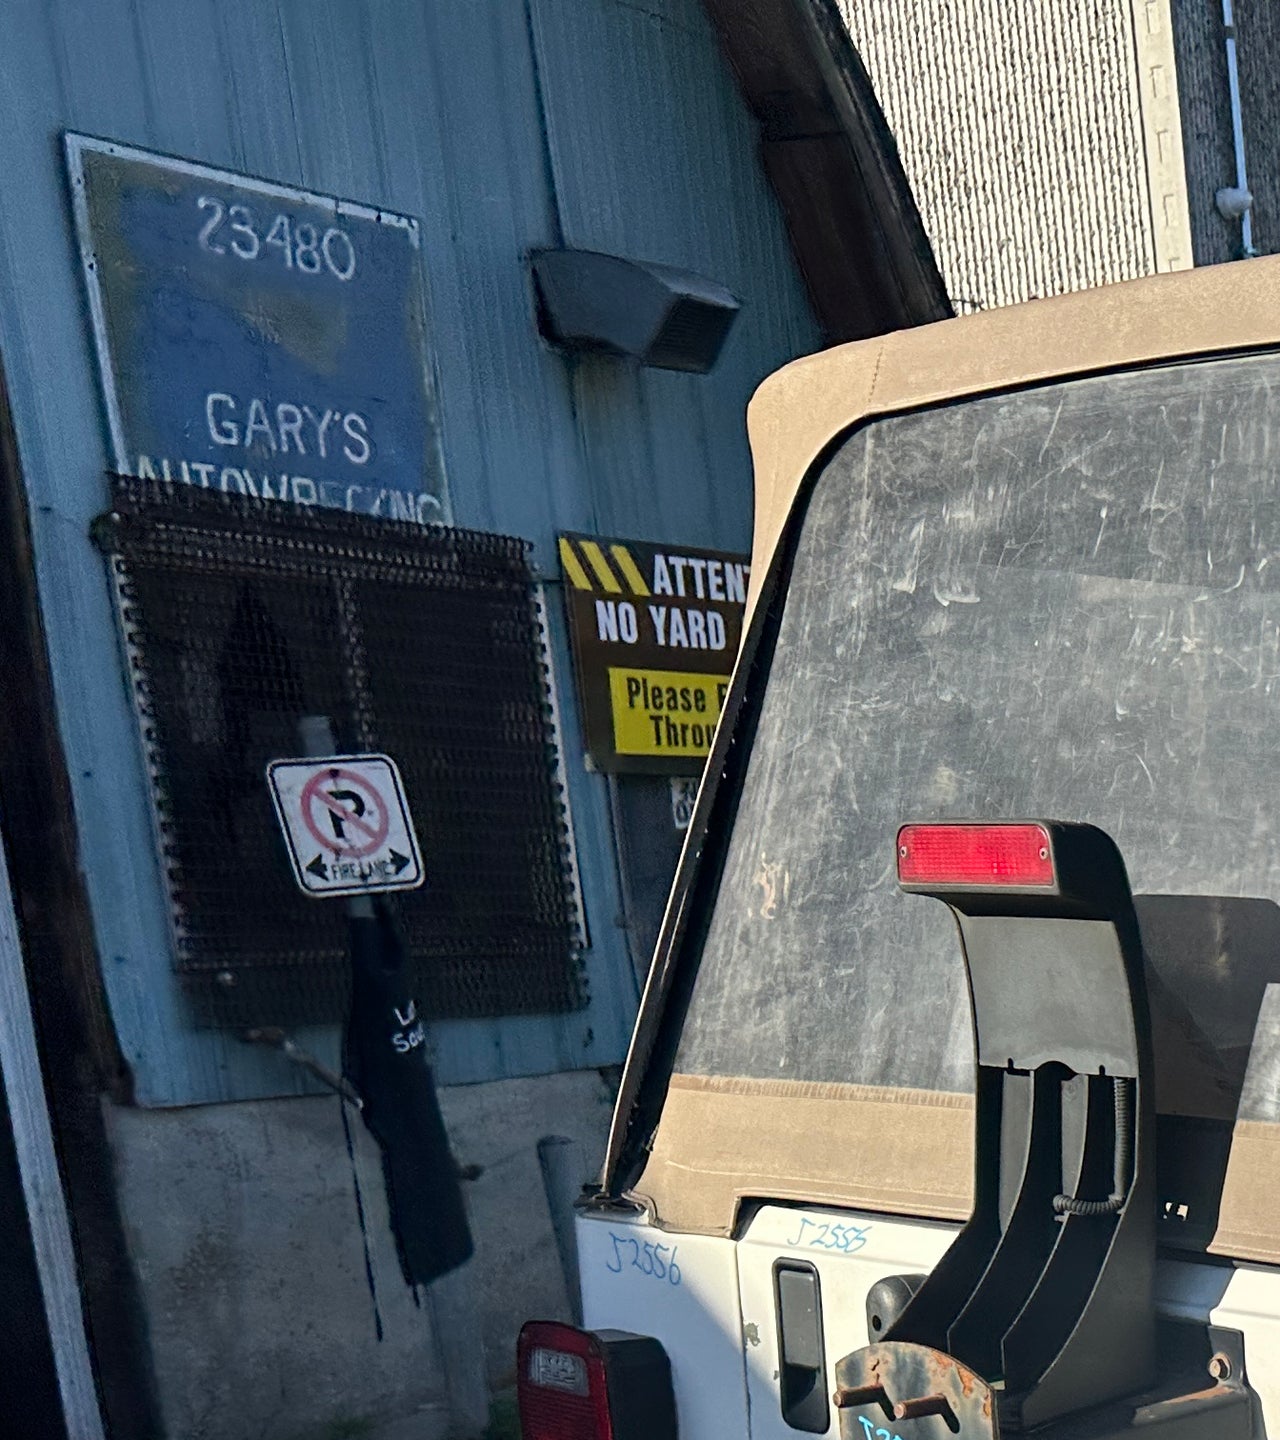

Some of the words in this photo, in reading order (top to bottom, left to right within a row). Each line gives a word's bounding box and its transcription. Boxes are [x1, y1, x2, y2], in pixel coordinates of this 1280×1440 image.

[197, 197, 357, 282] 23480
[206, 392, 371, 465] GARY'S
[652, 553, 751, 604] ATTEN
[595, 599, 638, 646] NO
[648, 604, 727, 651] YARD
[626, 675, 707, 714] Please
[331, 862, 357, 881] FIRE
[605, 1231, 682, 1286] J2556
